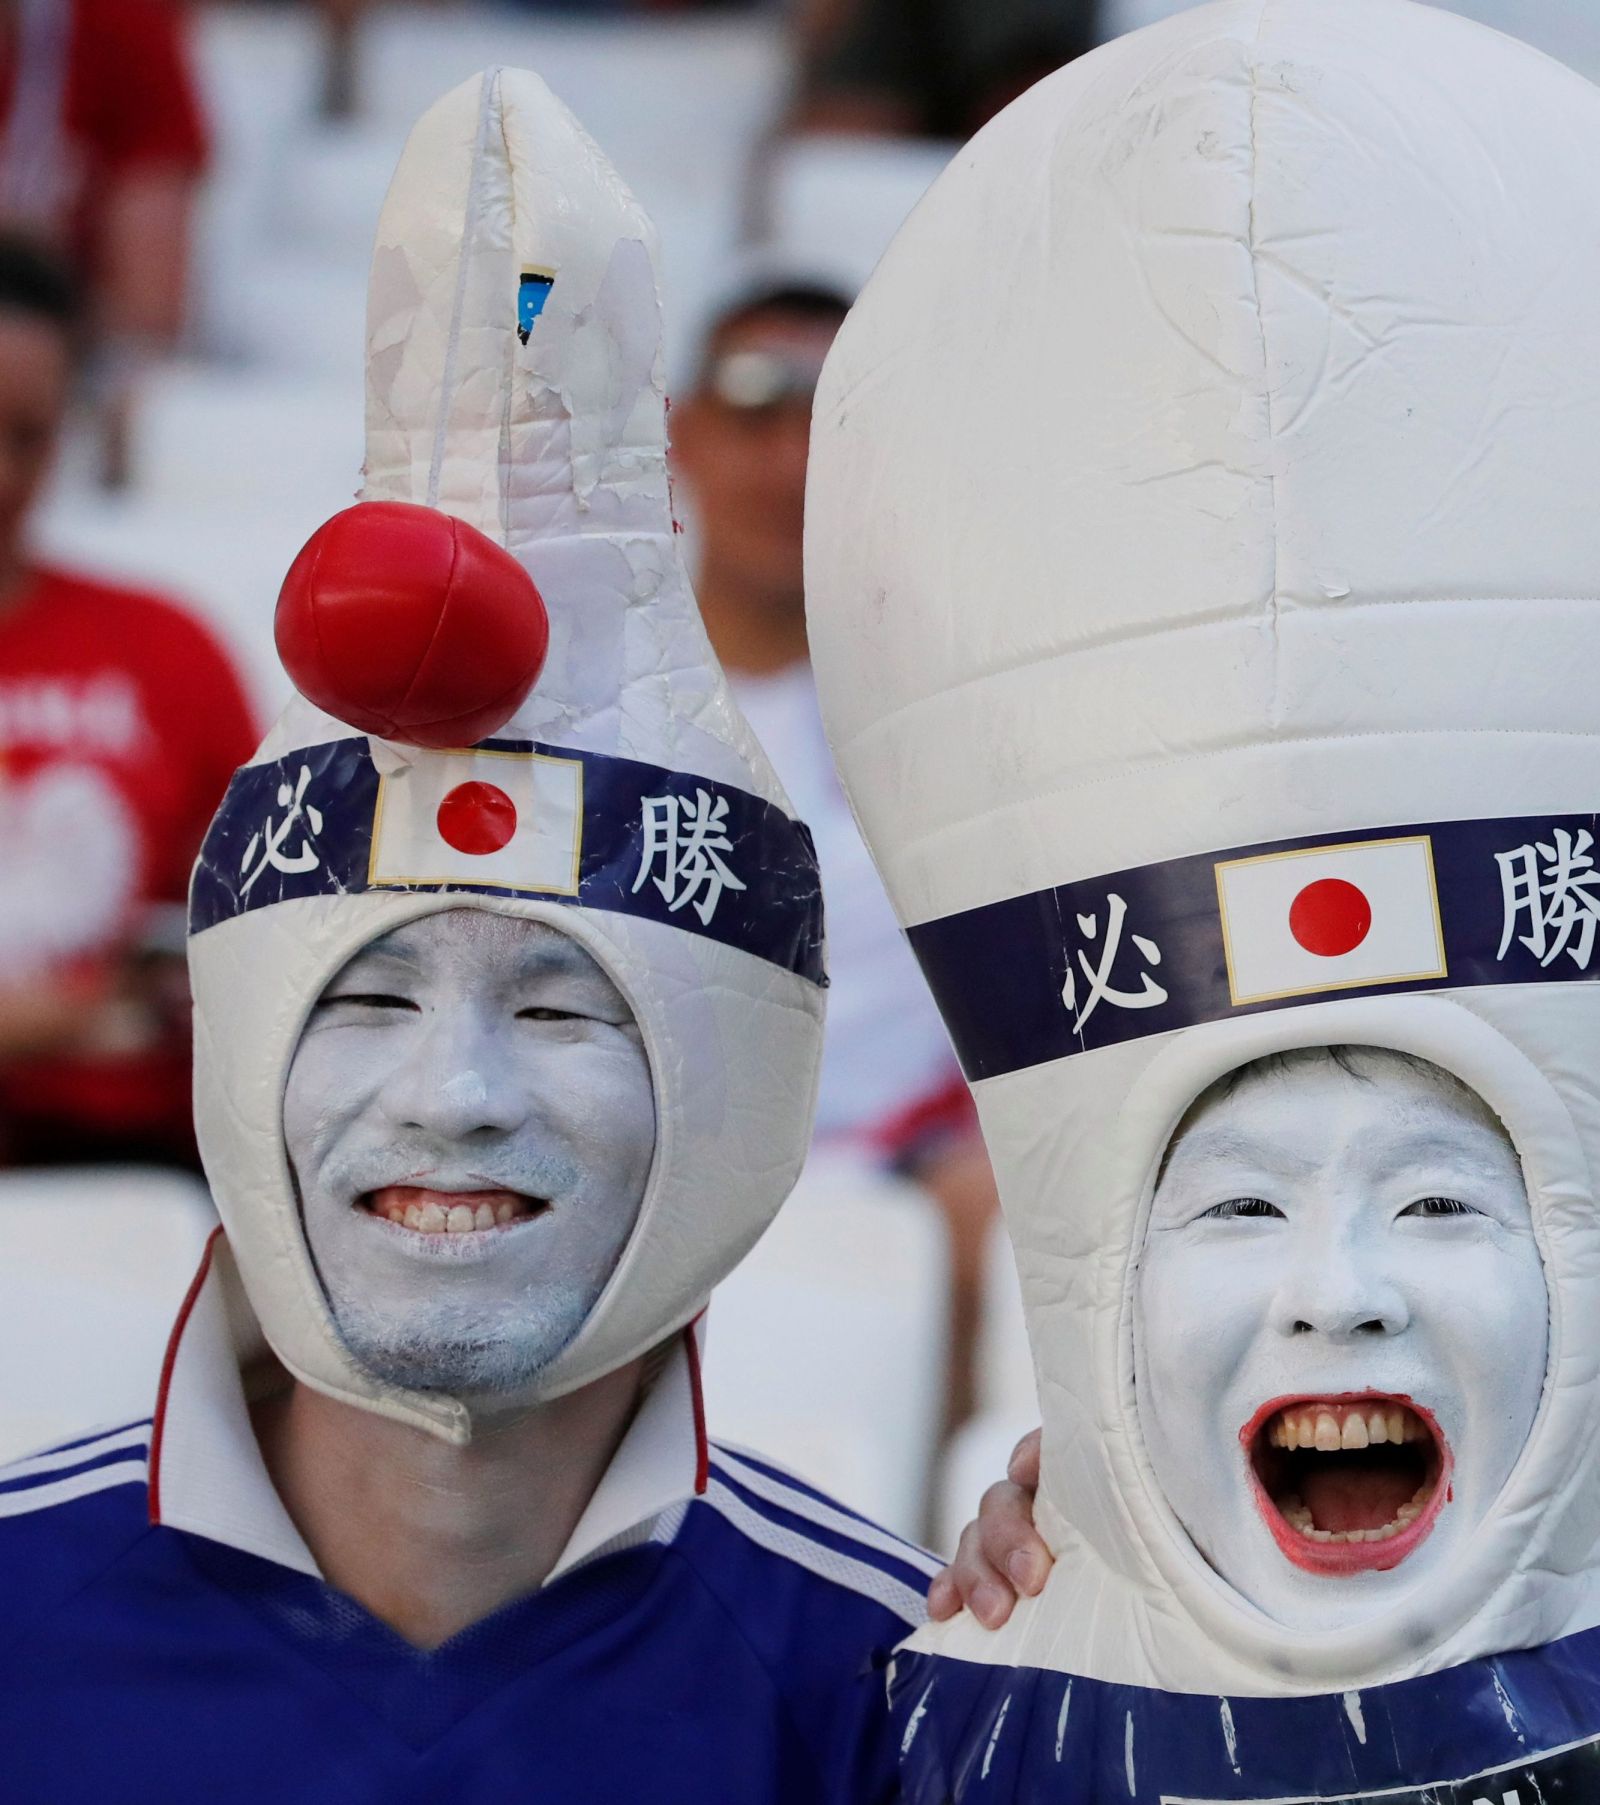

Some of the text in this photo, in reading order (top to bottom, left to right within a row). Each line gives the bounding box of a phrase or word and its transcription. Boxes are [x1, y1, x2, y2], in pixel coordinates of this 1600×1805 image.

[239, 764, 747, 926] 必 勝
[1060, 892, 1169, 1035] 必
